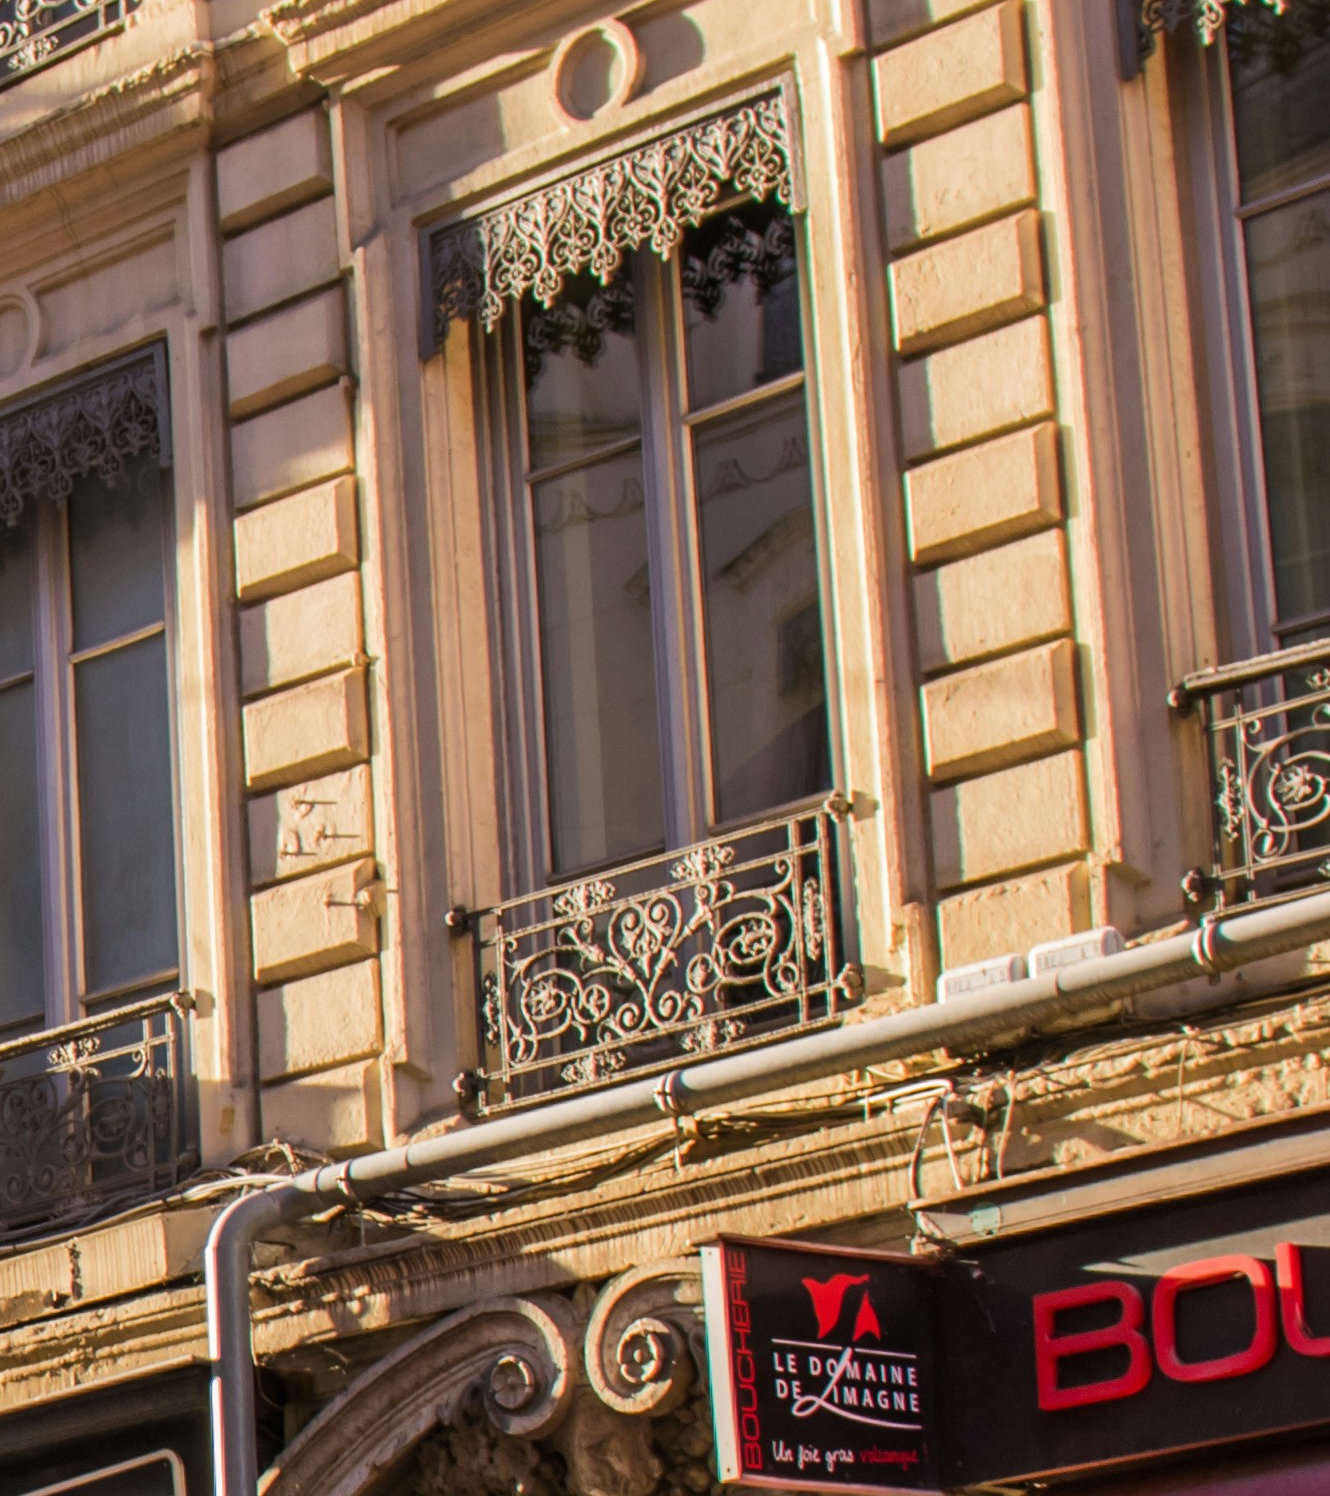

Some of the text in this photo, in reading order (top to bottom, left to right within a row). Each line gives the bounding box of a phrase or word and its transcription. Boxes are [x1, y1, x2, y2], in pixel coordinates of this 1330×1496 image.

[728, 1248, 763, 1469] BOUCHERIE
[772, 1352, 918, 1387] LE DOMAINE
[775, 1379, 802, 1400] DE
[772, 1440, 794, 1461] Un
[798, 1444, 821, 1470] foie
[825, 1448, 855, 1473] gras
